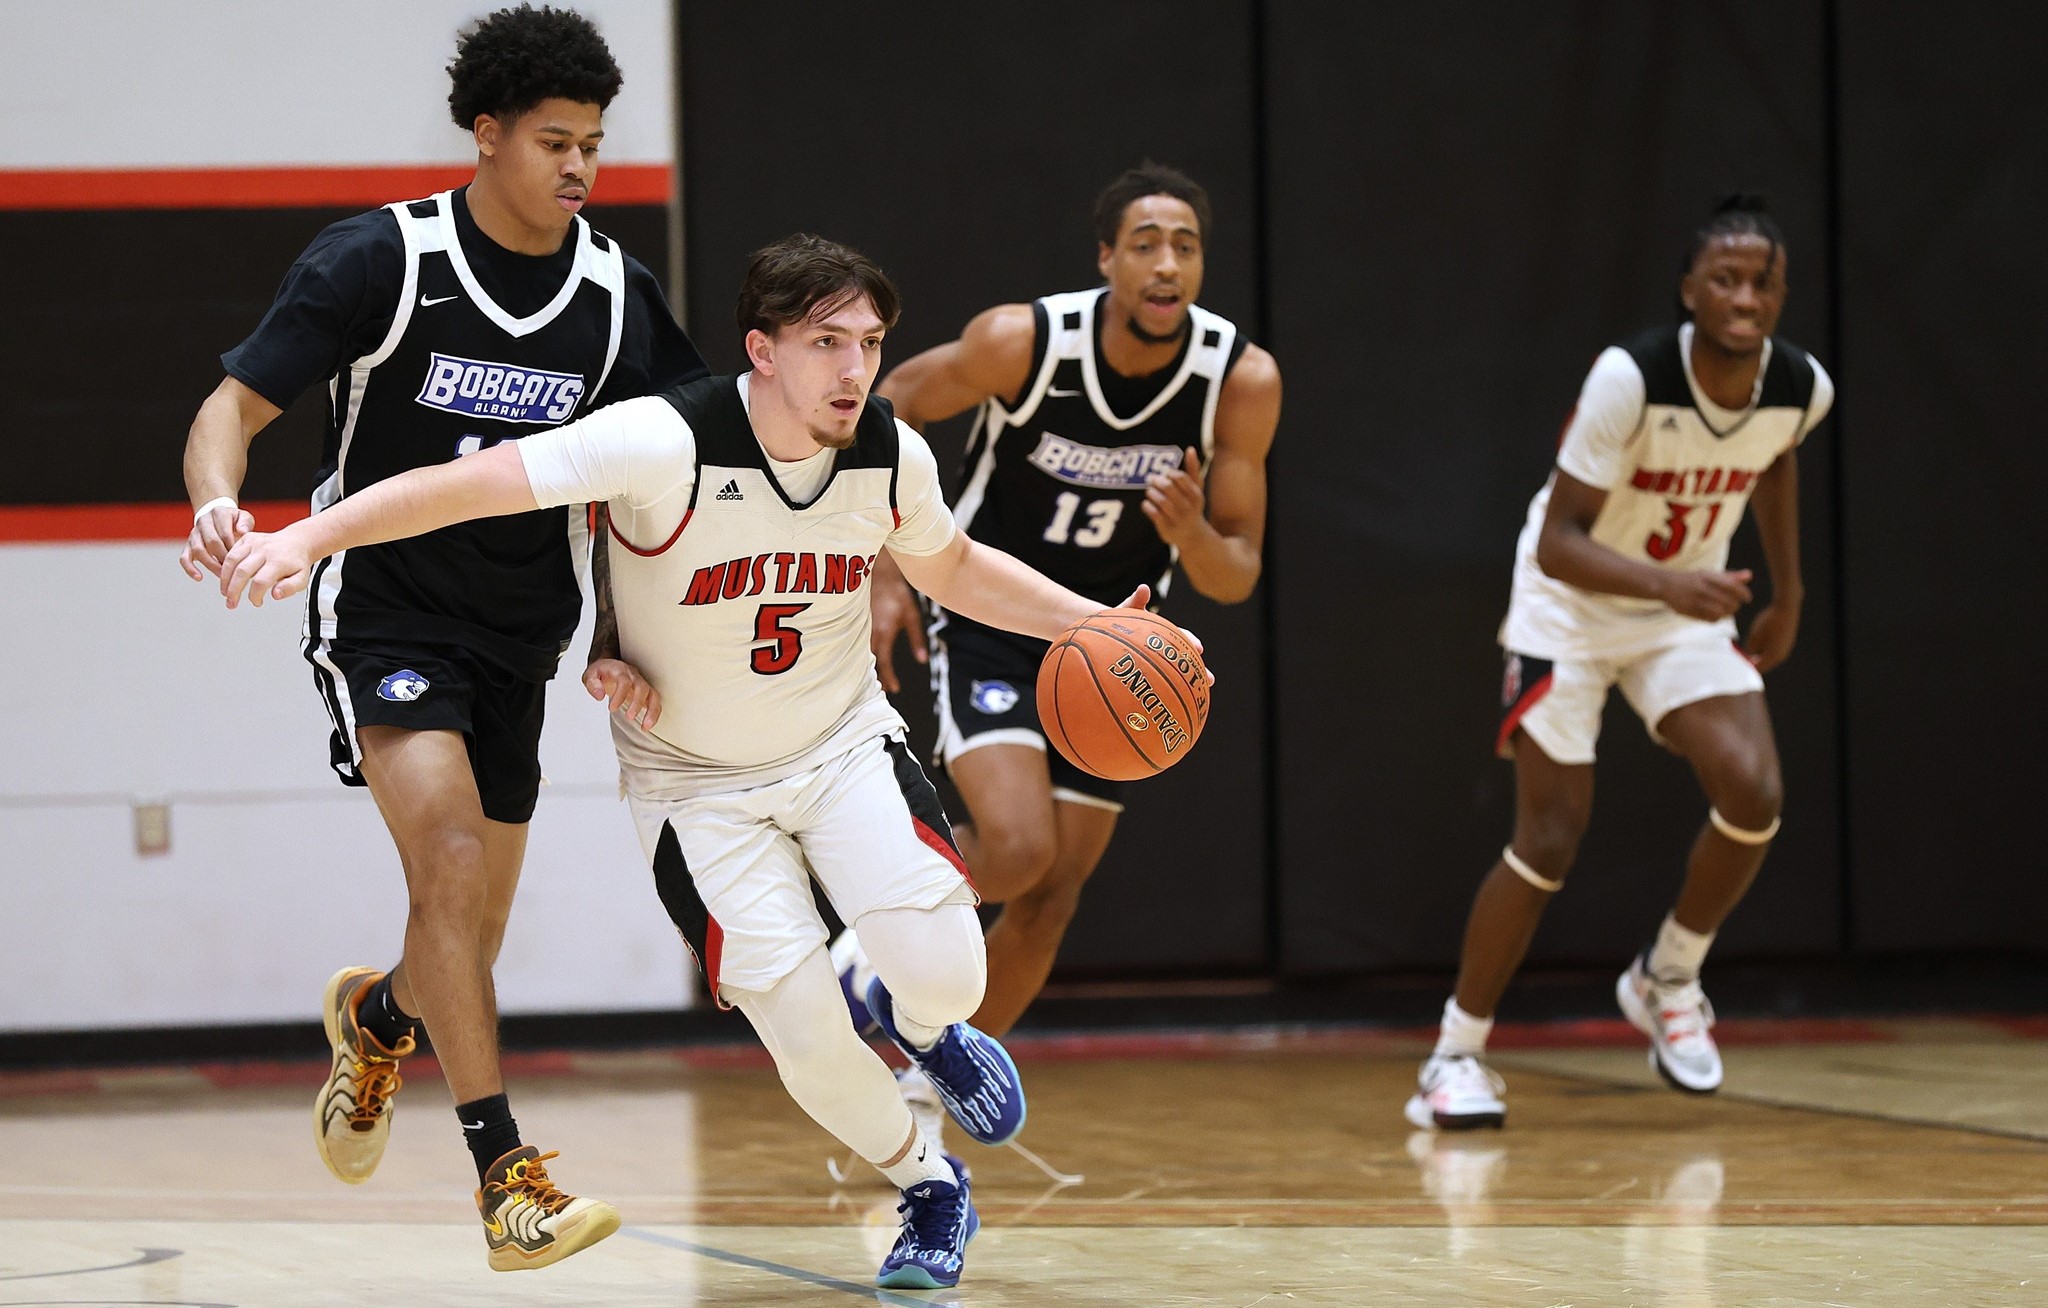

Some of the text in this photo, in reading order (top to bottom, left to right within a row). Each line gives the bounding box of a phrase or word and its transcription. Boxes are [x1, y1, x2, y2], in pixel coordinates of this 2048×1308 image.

[423, 359, 584, 420] BOBCATS
[474, 402, 527, 417] ALBANY
[1040, 441, 1177, 480] BOBCATS
[715, 490, 744, 501] adidas
[1042, 490, 1124, 548] 13
[1645, 501, 1723, 562] 31
[750, 602, 814, 676] 5
[1108, 653, 1189, 754] SPALDING
